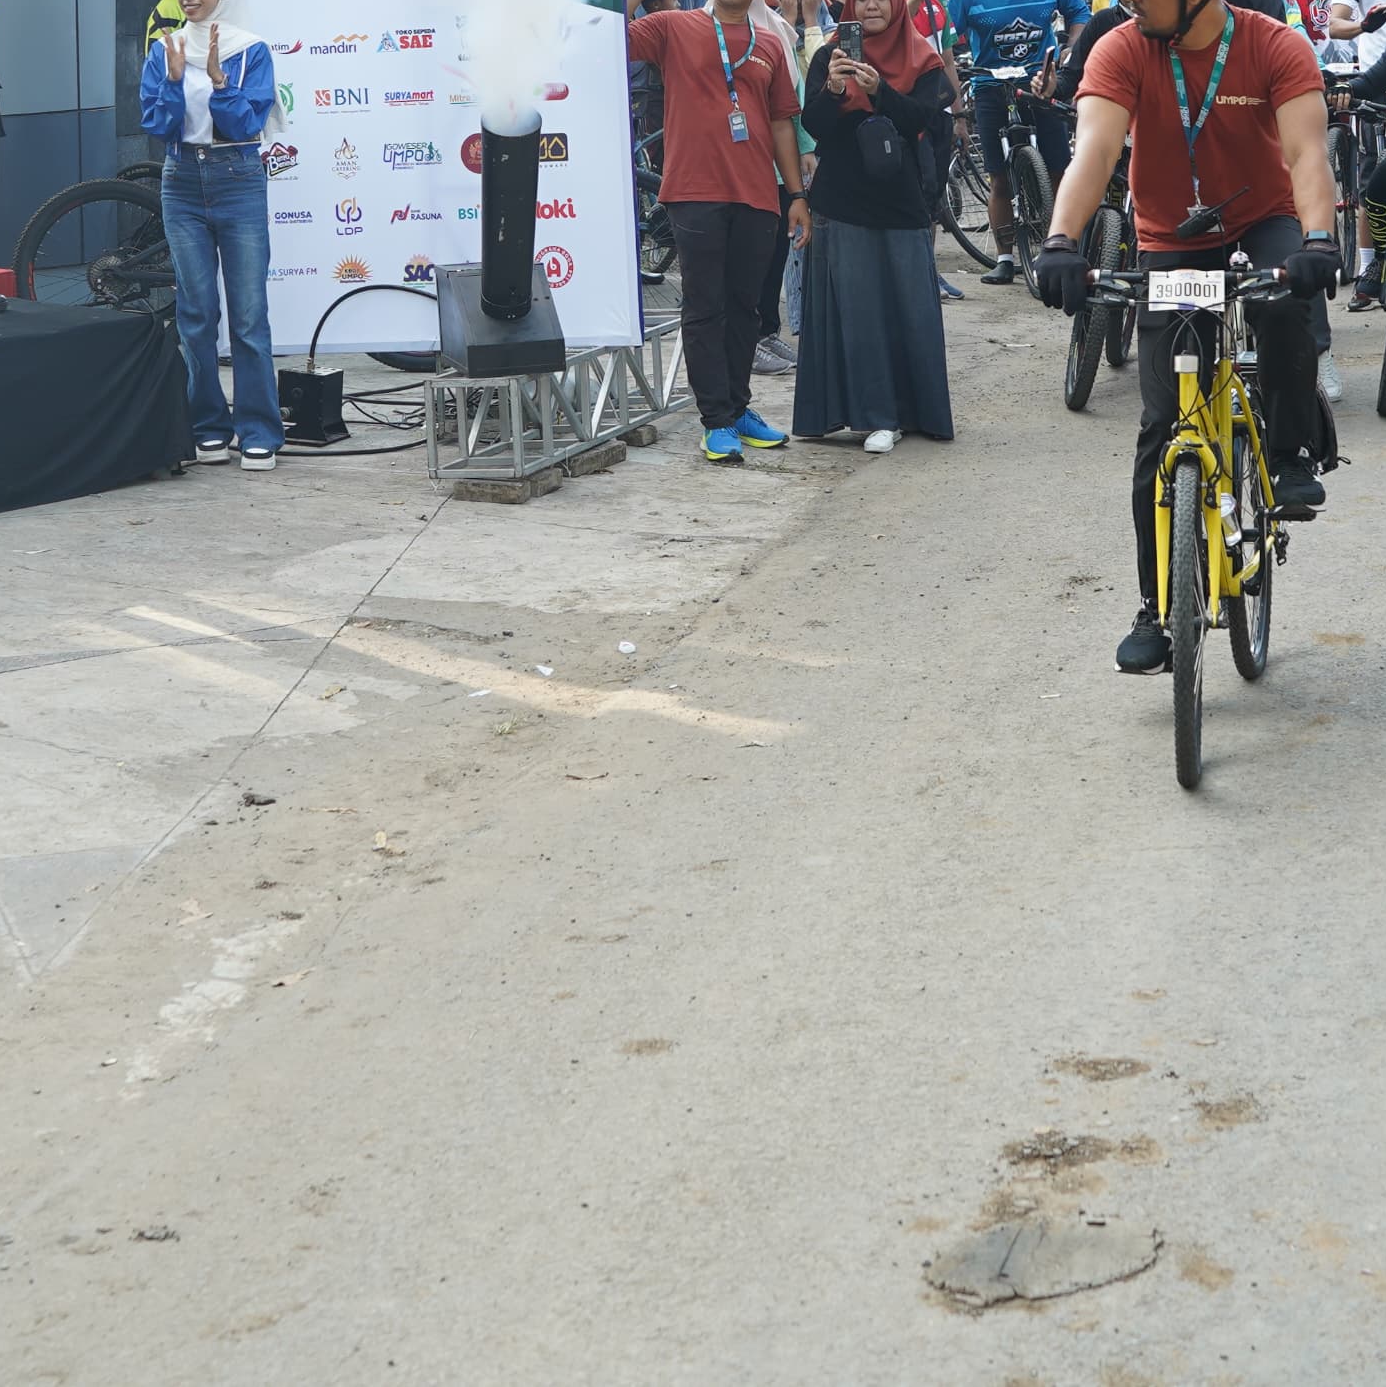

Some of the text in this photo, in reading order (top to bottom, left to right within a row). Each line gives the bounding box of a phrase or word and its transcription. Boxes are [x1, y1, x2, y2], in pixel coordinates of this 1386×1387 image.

[399, 35, 433, 49] SAE
[310, 42, 357, 55] mandiri
[334, 88, 369, 105] BNI
[1215, 96, 1247, 105] UMPO
[274, 211, 312, 220] GONUSA
[410, 212, 443, 221] RASUNA
[458, 208, 478, 219] BSI
[336, 226, 363, 236] LDP
[278, 268, 305, 277] SURYA
[306, 267, 317, 276] FM
[1156, 282, 1217, 299] 3900001
